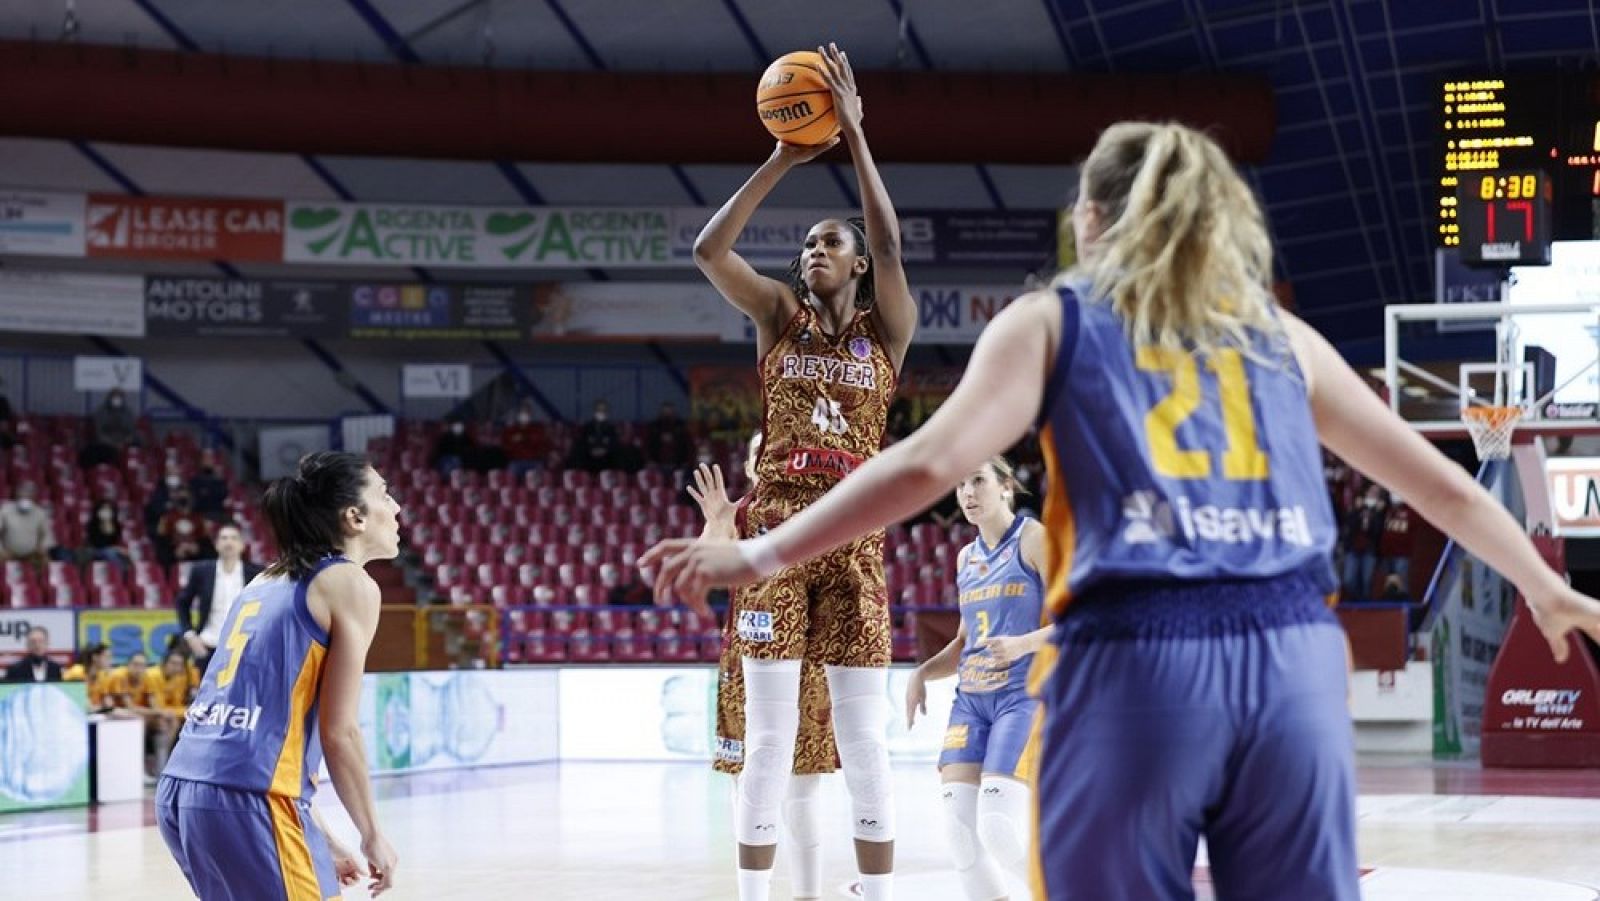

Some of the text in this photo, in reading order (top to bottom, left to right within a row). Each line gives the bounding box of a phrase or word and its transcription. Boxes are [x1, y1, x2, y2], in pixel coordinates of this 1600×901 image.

[134, 204, 281, 232] LEASE CAR
[147, 302, 263, 322] MOTORS
[434, 370, 461, 391] VI
[782, 354, 876, 390] REYER
[1135, 345, 1269, 479] 21
[1176, 497, 1312, 546] isaval
[975, 610, 990, 643] 3
[217, 601, 262, 689] 5
